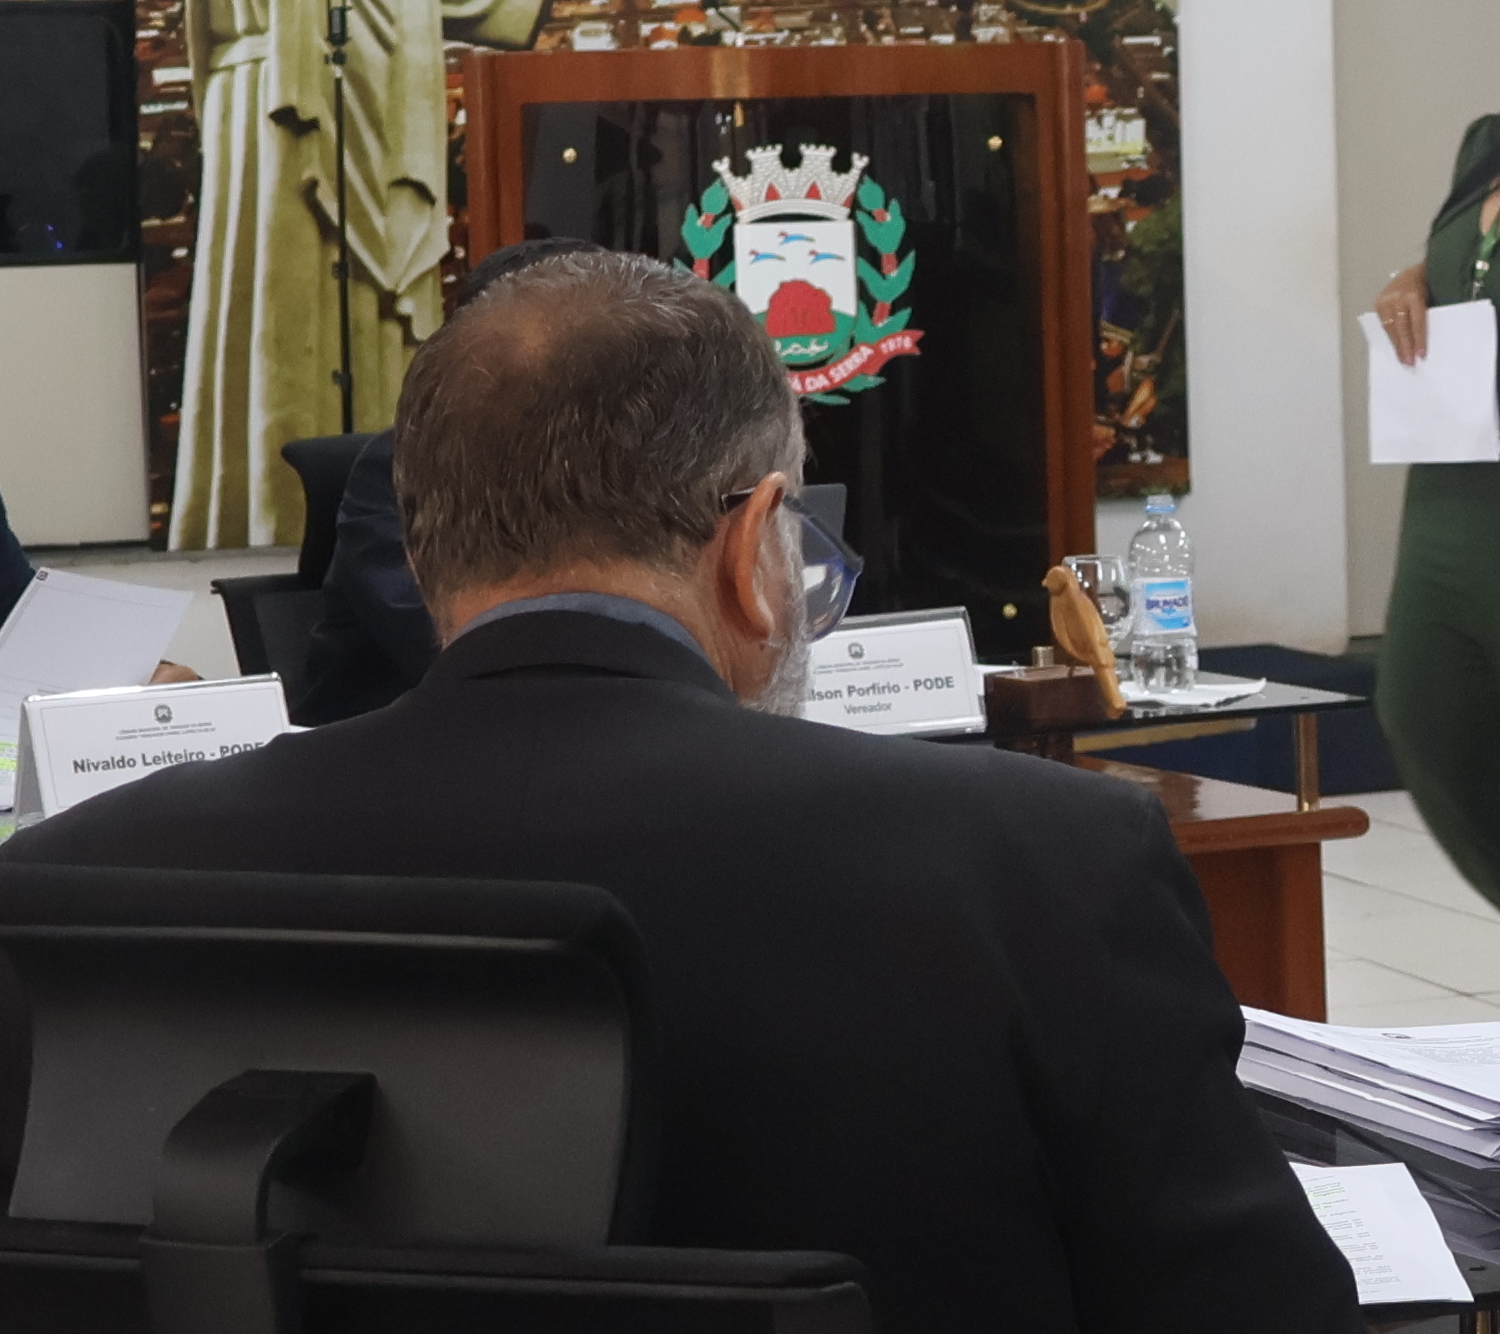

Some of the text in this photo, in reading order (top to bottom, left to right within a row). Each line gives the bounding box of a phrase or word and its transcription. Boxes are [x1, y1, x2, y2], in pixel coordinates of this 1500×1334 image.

[913, 675, 955, 692] PODE
[844, 702, 892, 715] Vereador
[72, 753, 137, 774] Nivaldo
[141, 748, 206, 767] Leiteiro
